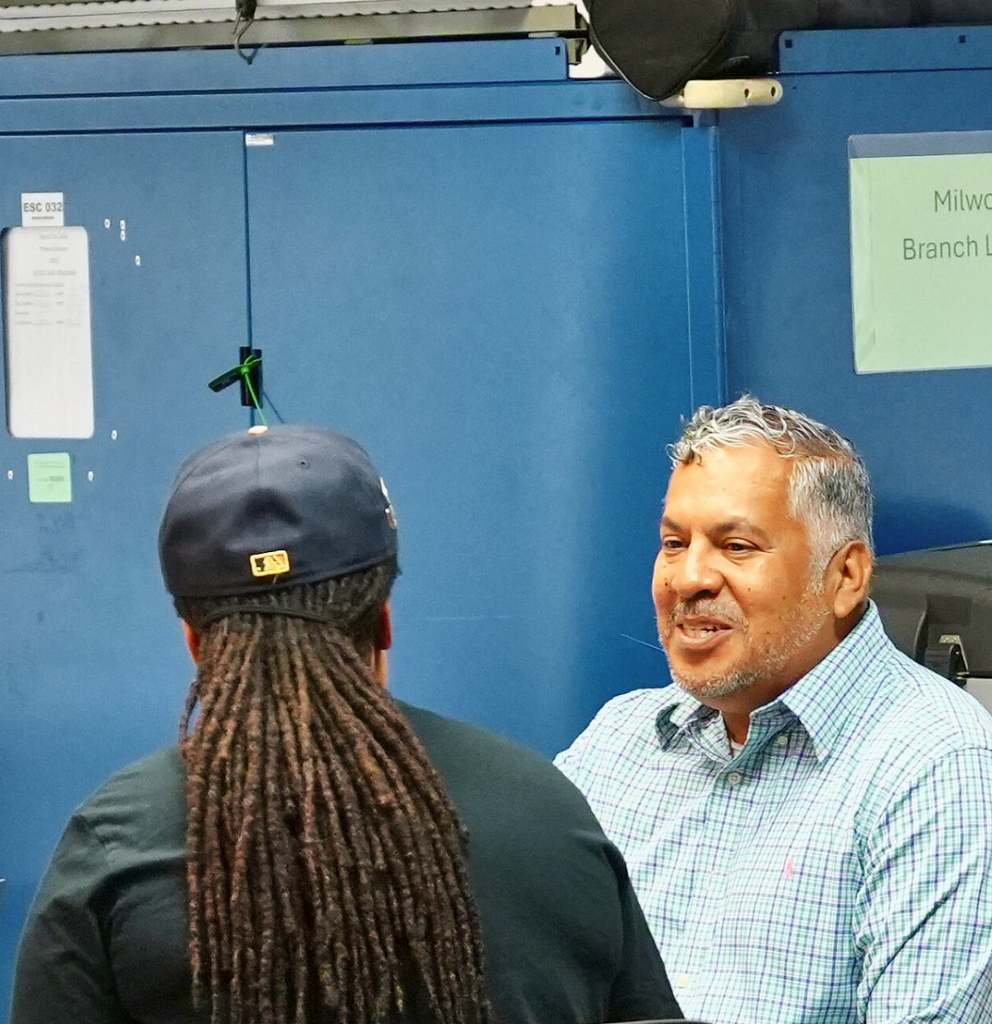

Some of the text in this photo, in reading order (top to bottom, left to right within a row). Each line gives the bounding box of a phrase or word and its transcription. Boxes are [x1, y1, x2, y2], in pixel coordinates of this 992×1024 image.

[23, 202, 63, 212] ESC 032
[903, 235, 978, 260] Branch
